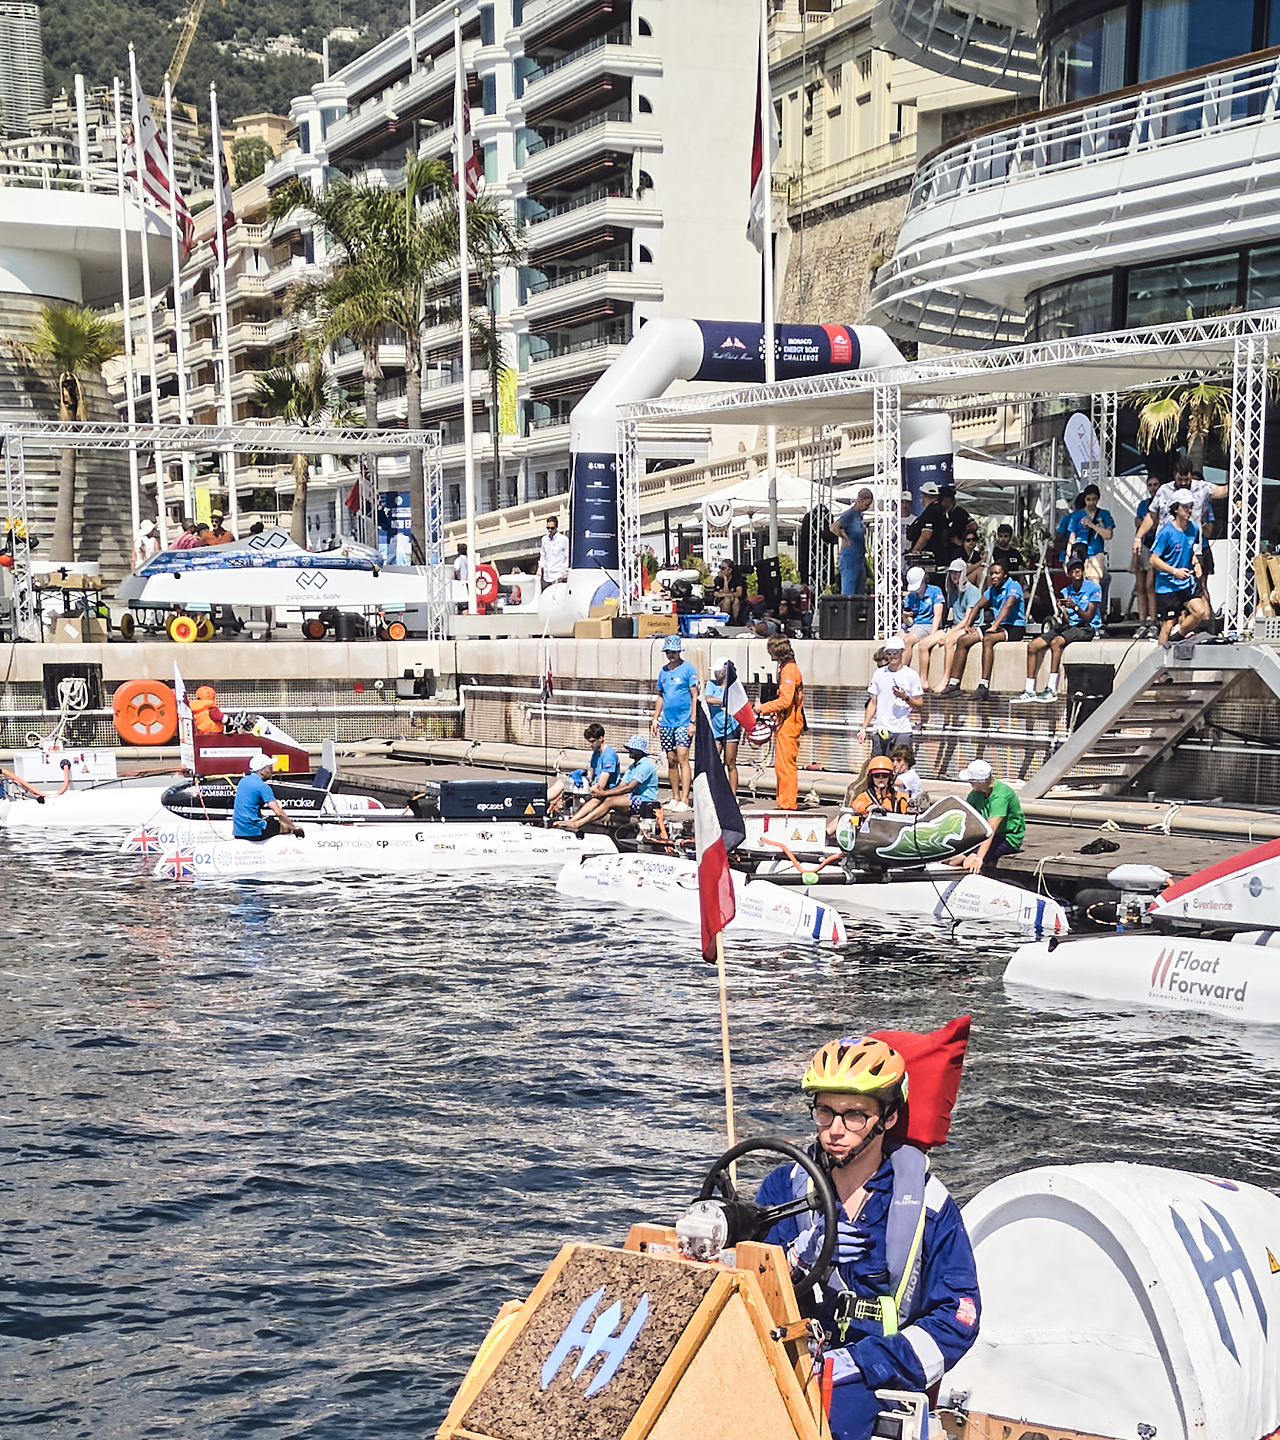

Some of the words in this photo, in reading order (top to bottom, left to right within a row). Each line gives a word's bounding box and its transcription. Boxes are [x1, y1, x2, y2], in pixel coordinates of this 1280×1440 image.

[783, 354, 819, 362] CHALLENGE
[160, 833, 175, 844] 02
[317, 838, 373, 850] snapmaker
[376, 839, 414, 849] cpcases
[195, 853, 212, 865] 02
[803, 913, 811, 927] 11
[1174, 950, 1220, 974] Float
[1169, 972, 1248, 1002] Forward
[903, 1266, 920, 1302] PILOT
